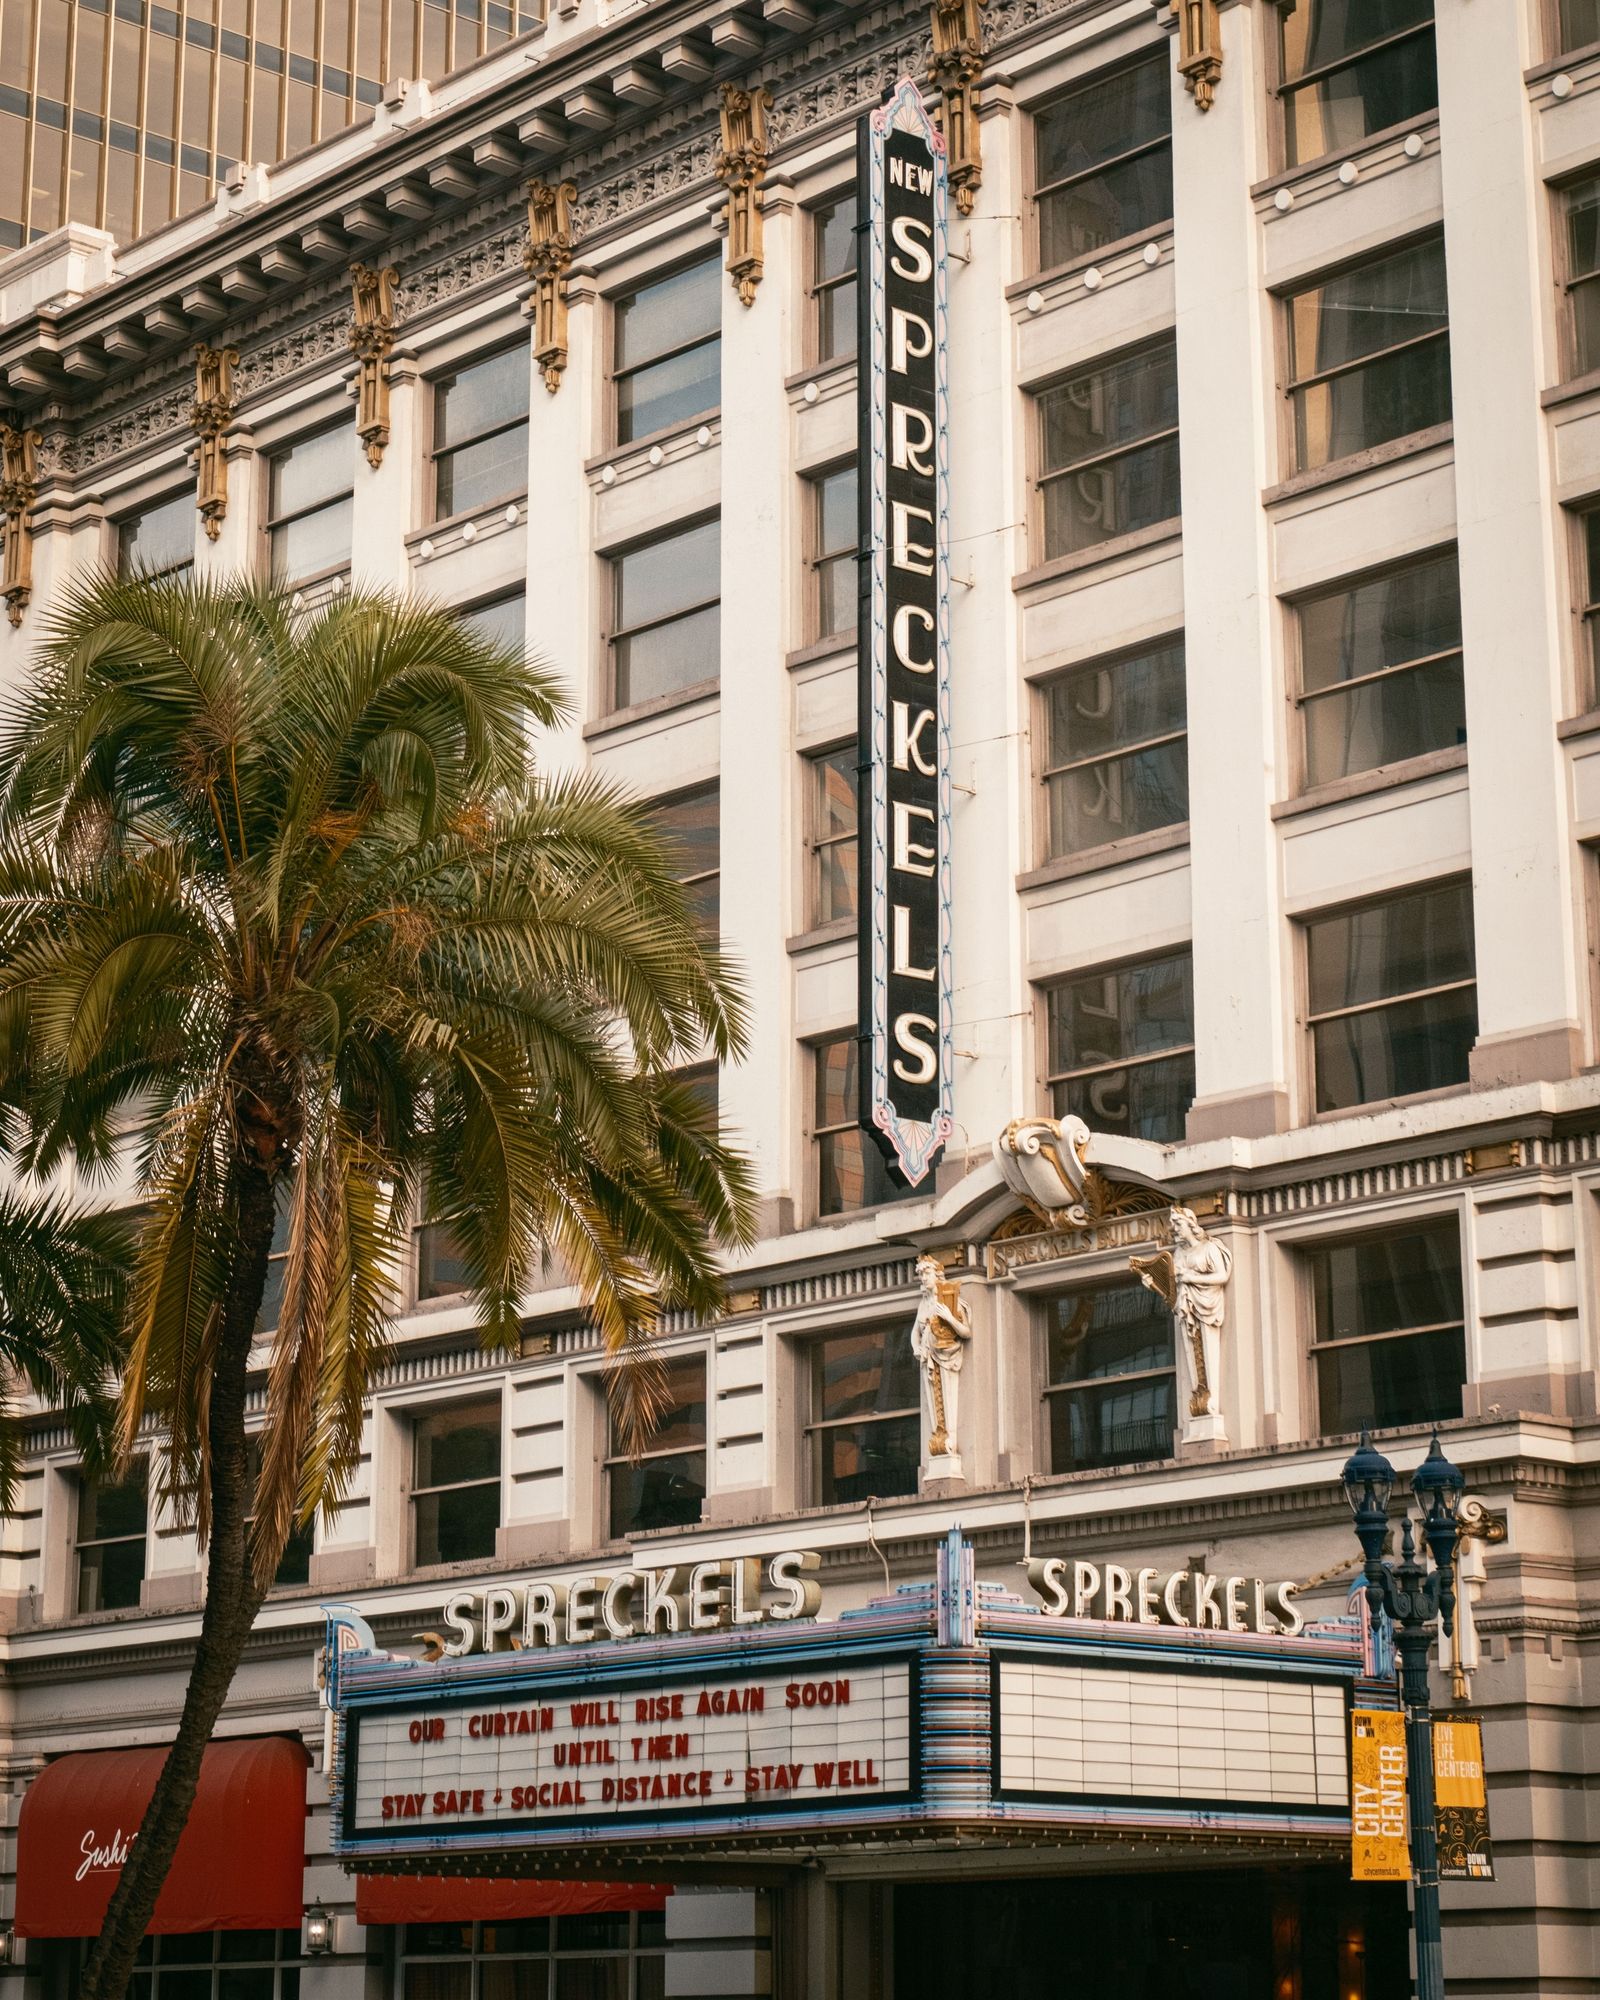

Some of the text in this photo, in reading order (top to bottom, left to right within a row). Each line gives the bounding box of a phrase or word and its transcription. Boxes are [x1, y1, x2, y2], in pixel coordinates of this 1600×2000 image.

[890, 157, 933, 197] NEW
[890, 215, 937, 1084] SPRECKELS
[994, 1214, 1173, 1276] SPRECKELS BUILDIN
[443, 1551, 822, 1657] SPRECKELS
[1028, 1558, 1304, 1636] SPRECKELS
[409, 1679, 851, 1744] OUR CURTAIN WILL RISE AGAIN SOON
[1355, 1716, 1372, 1727] DOWN
[1436, 1725, 1454, 1742] LIVE
[554, 1733, 689, 1767] UNTIL THEN
[1437, 1743, 1455, 1760] LIFE
[1437, 1760, 1481, 1779] CENTERED
[382, 1758, 879, 1819] STAY SAFE SOCIAL DISTANCE STAY WELL
[1354, 1782, 1379, 1837] CITY
[1379, 1745, 1404, 1838] CENTER
[75, 1828, 130, 1882] Sushi
[1467, 1853, 1487, 1865] DOWN
